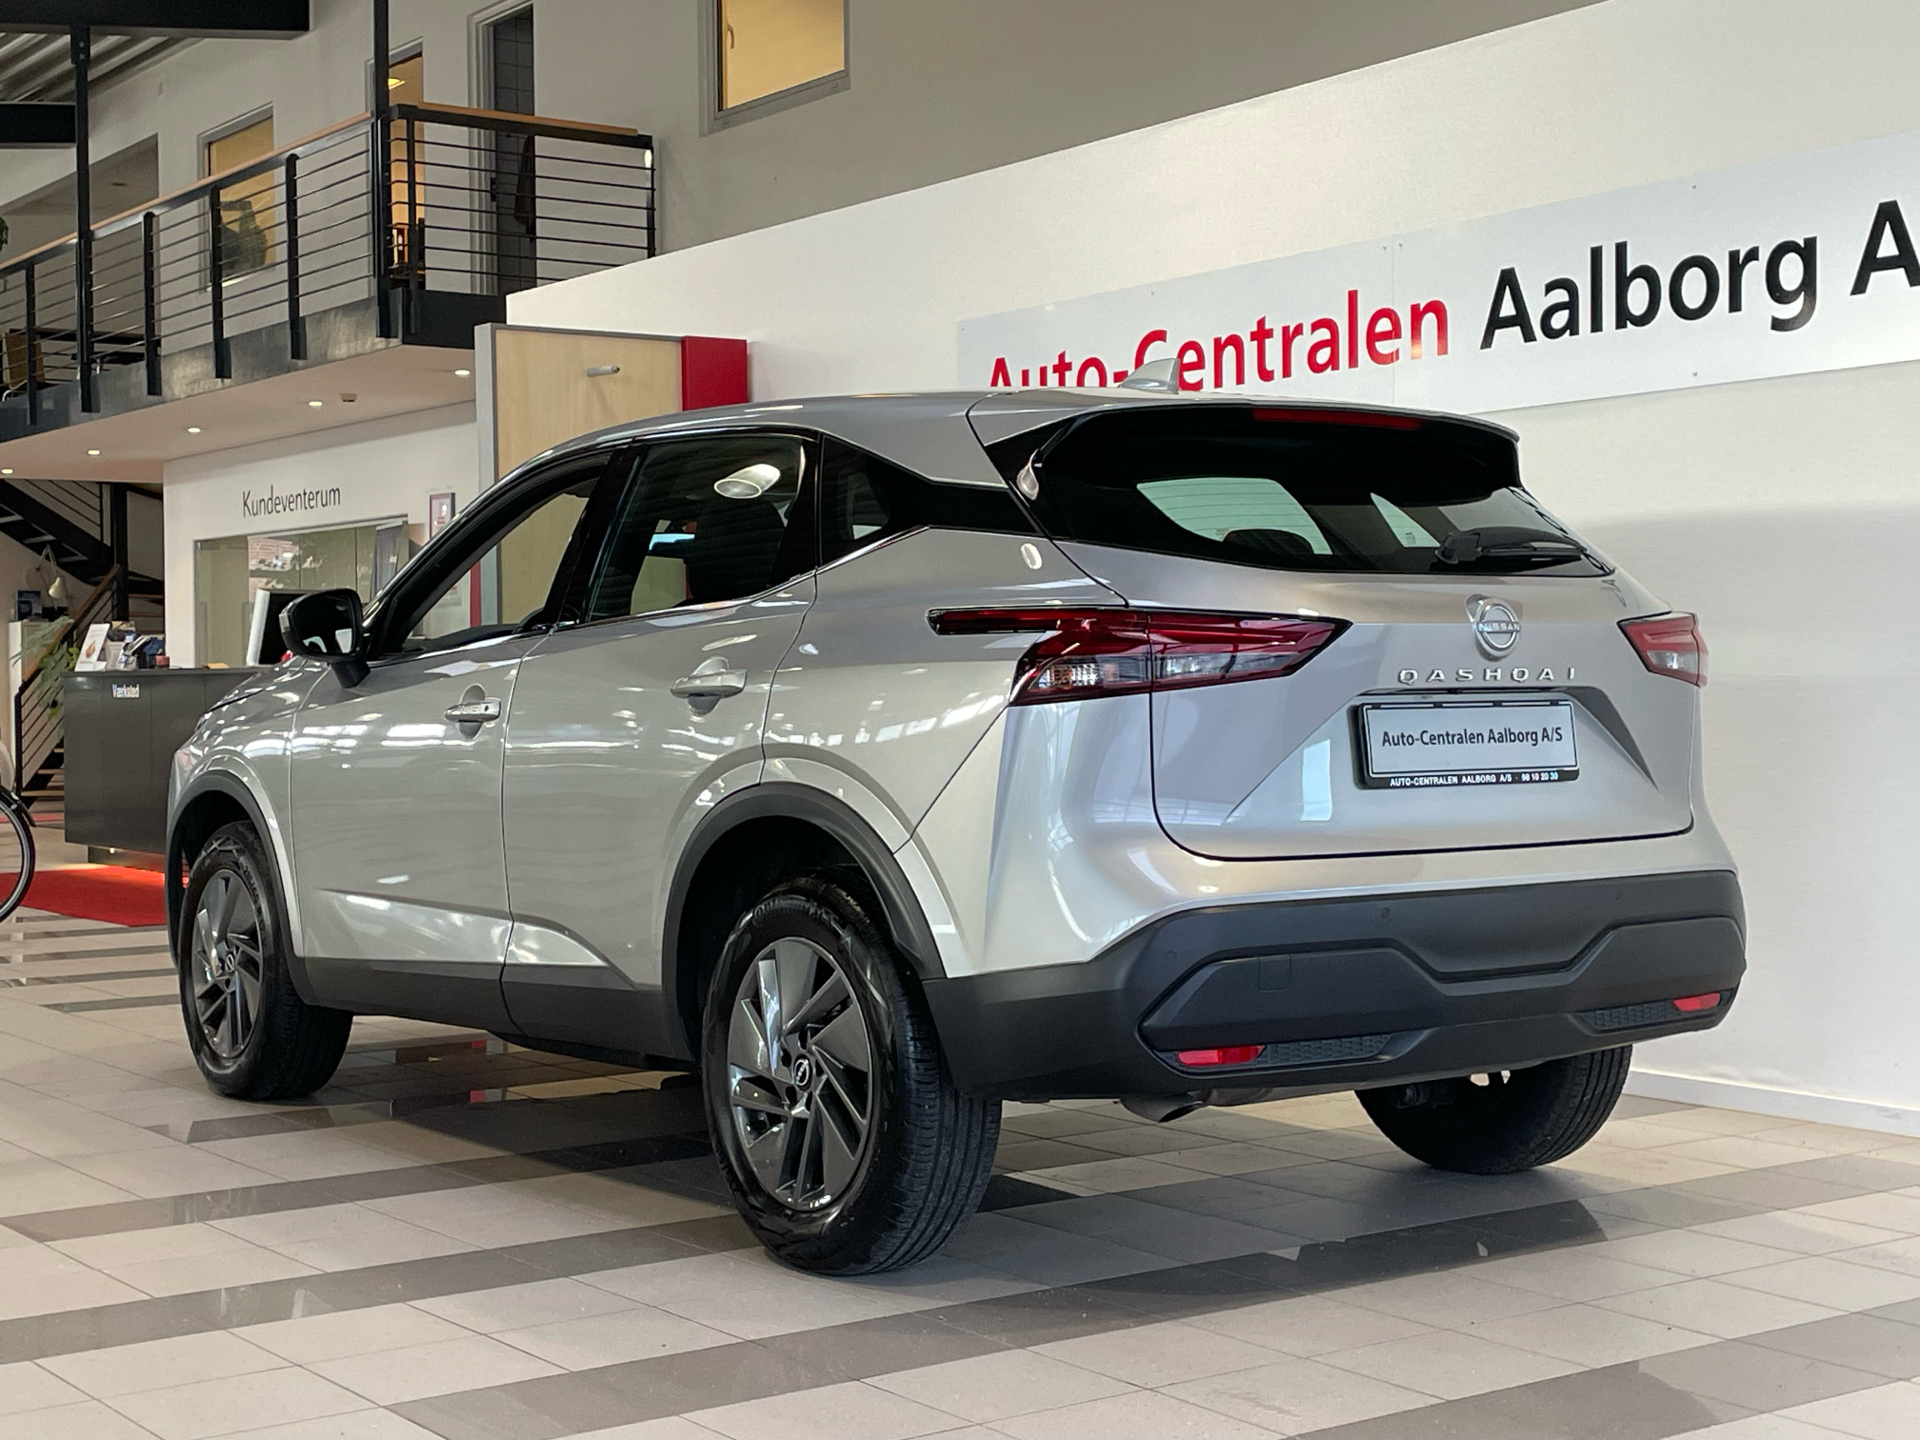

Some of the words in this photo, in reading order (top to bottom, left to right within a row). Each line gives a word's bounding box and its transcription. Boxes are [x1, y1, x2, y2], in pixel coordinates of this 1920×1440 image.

[1480, 235, 1818, 350] Aalborg
[243, 484, 341, 518] Kundeventerum
[1478, 622, 1520, 631] NISSAN
[1398, 667, 1576, 685] QASHQAI
[1382, 728, 1484, 747] Auto-Centralen
[1488, 727, 1538, 746] Aalborg
[1541, 726, 1563, 742] A/S
[1389, 776, 1458, 787] AUTO-CENTRALEN
[1461, 774, 1496, 785] AALBORG
[1500, 773, 1512, 782] A/S
